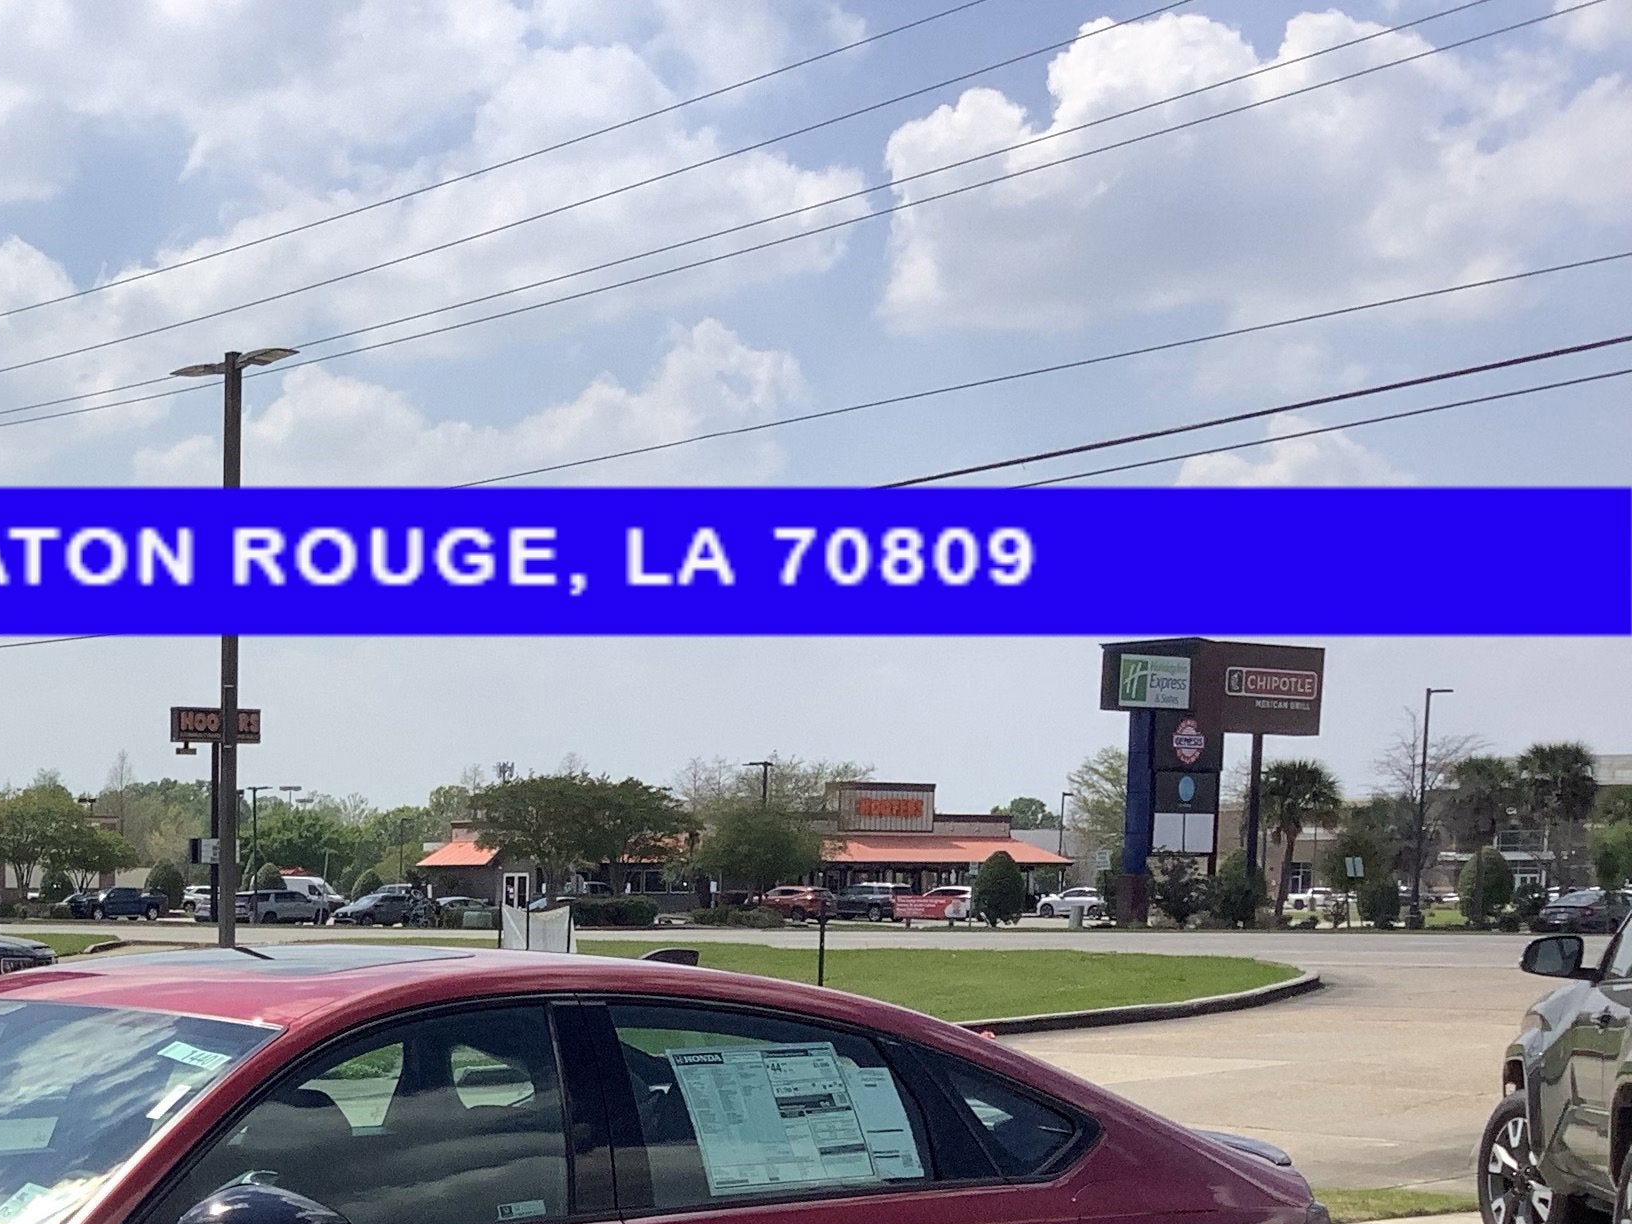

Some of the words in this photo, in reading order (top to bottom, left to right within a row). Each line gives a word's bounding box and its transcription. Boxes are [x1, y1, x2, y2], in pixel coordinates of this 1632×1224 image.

[1150, 673, 1187, 692] Express
[1247, 674, 1313, 693] CHIPOTLE
[180, 711, 258, 732] HOORS
[684, 1053, 722, 1064] HONDA
